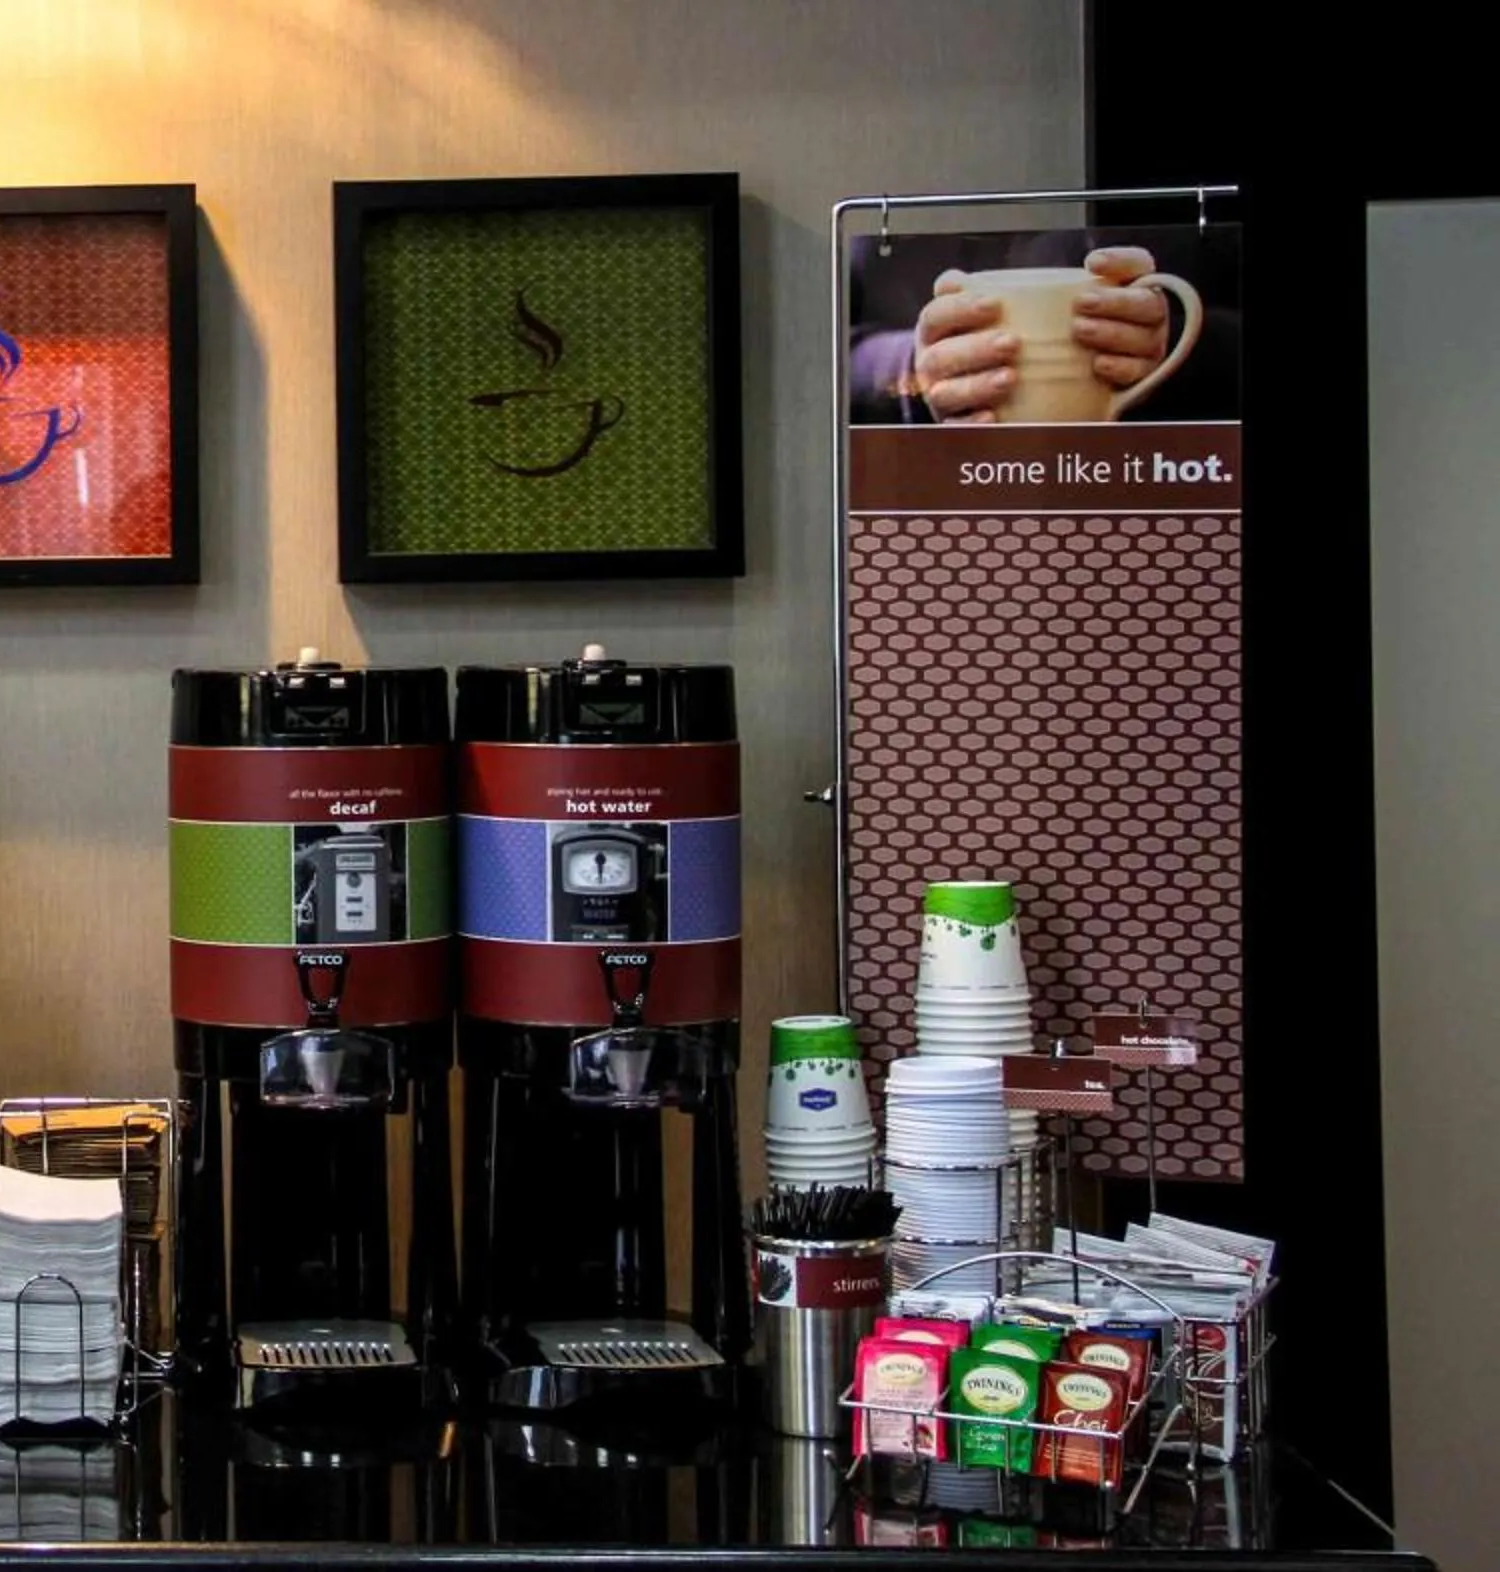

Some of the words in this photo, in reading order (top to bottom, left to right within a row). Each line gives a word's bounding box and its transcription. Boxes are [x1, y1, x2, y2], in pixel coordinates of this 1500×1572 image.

[959, 460, 1045, 484] some
[1057, 453, 1111, 484] like
[1124, 454, 1144, 483] it
[1153, 452, 1233, 483] hot.
[329, 799, 377, 815] decaf
[566, 799, 597, 813] hot
[601, 800, 653, 813] water
[300, 954, 343, 965] FETCO
[605, 954, 648, 965] FETCO
[1120, 1034, 1139, 1045] hot
